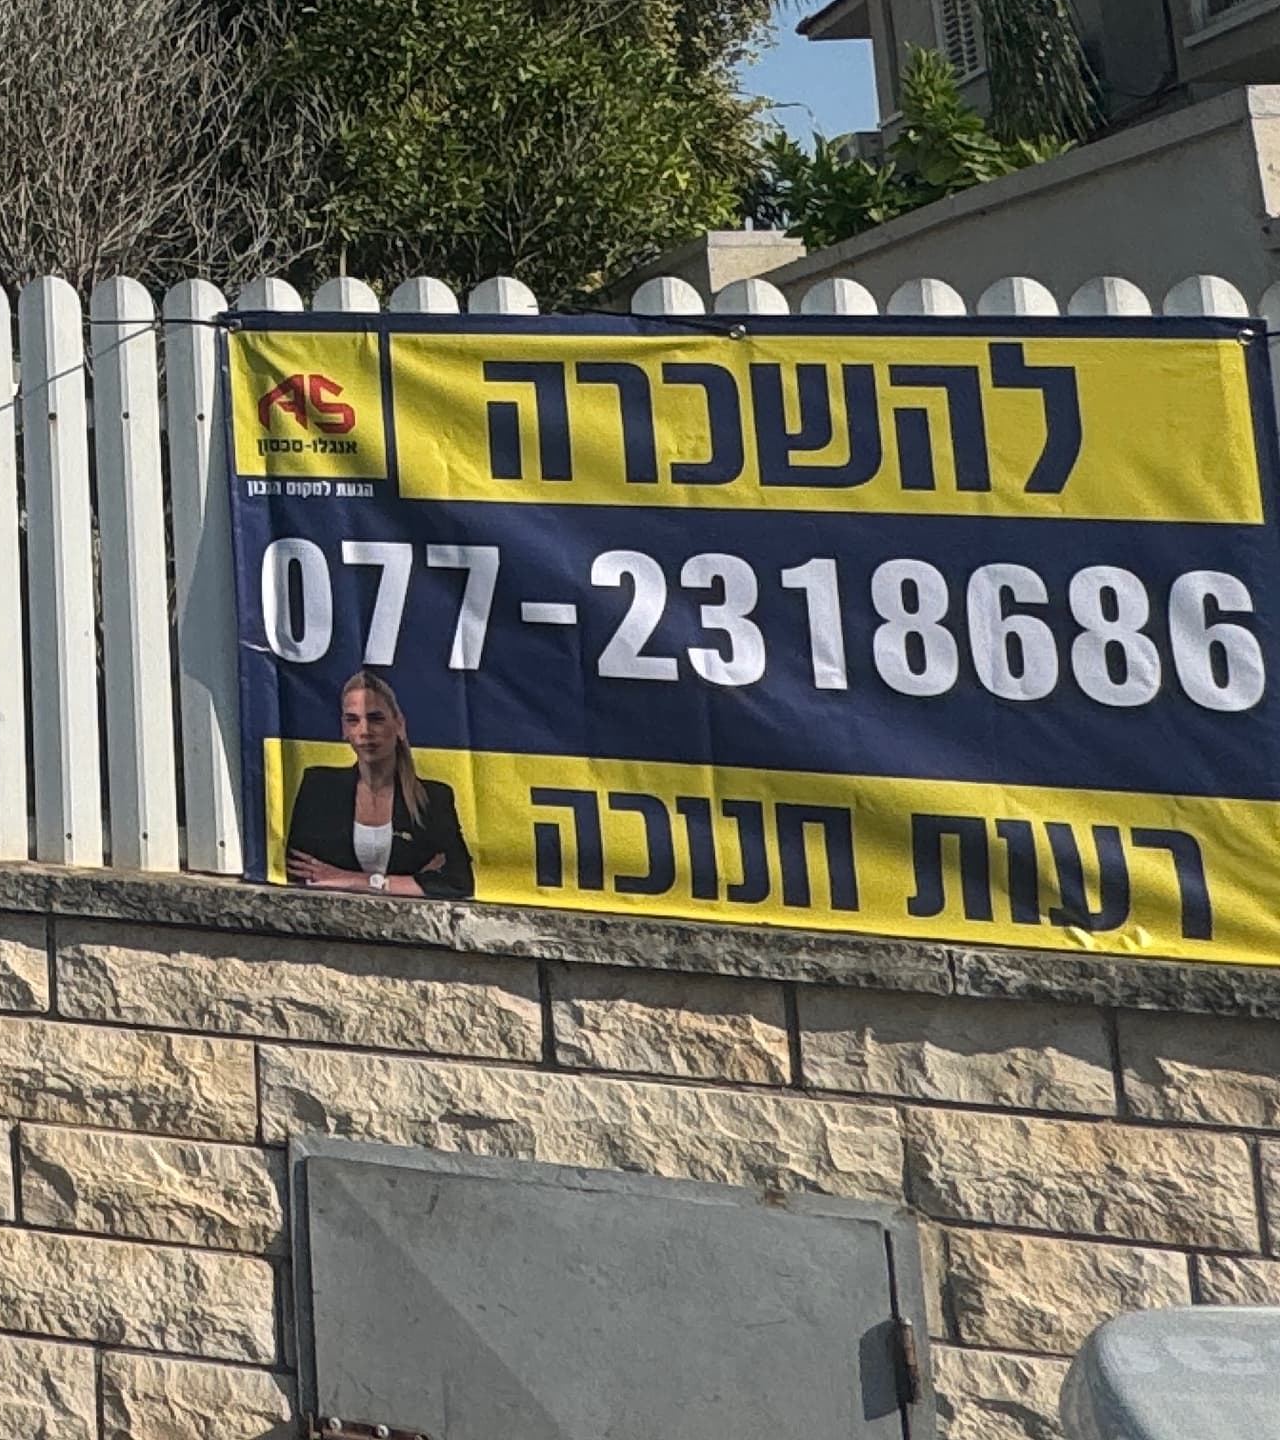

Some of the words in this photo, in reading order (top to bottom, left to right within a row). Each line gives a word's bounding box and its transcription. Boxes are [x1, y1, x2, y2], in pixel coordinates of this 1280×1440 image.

[258, 438, 357, 456] אנגלו-סכסון
[483, 343, 1082, 495] להשכרה
[286, 480, 330, 498] למקום
[336, 483, 373, 497] הגעת
[260, 537, 1265, 712] 077-2318686
[529, 786, 860, 911] חנוכה
[906, 812, 1214, 940] רעות
